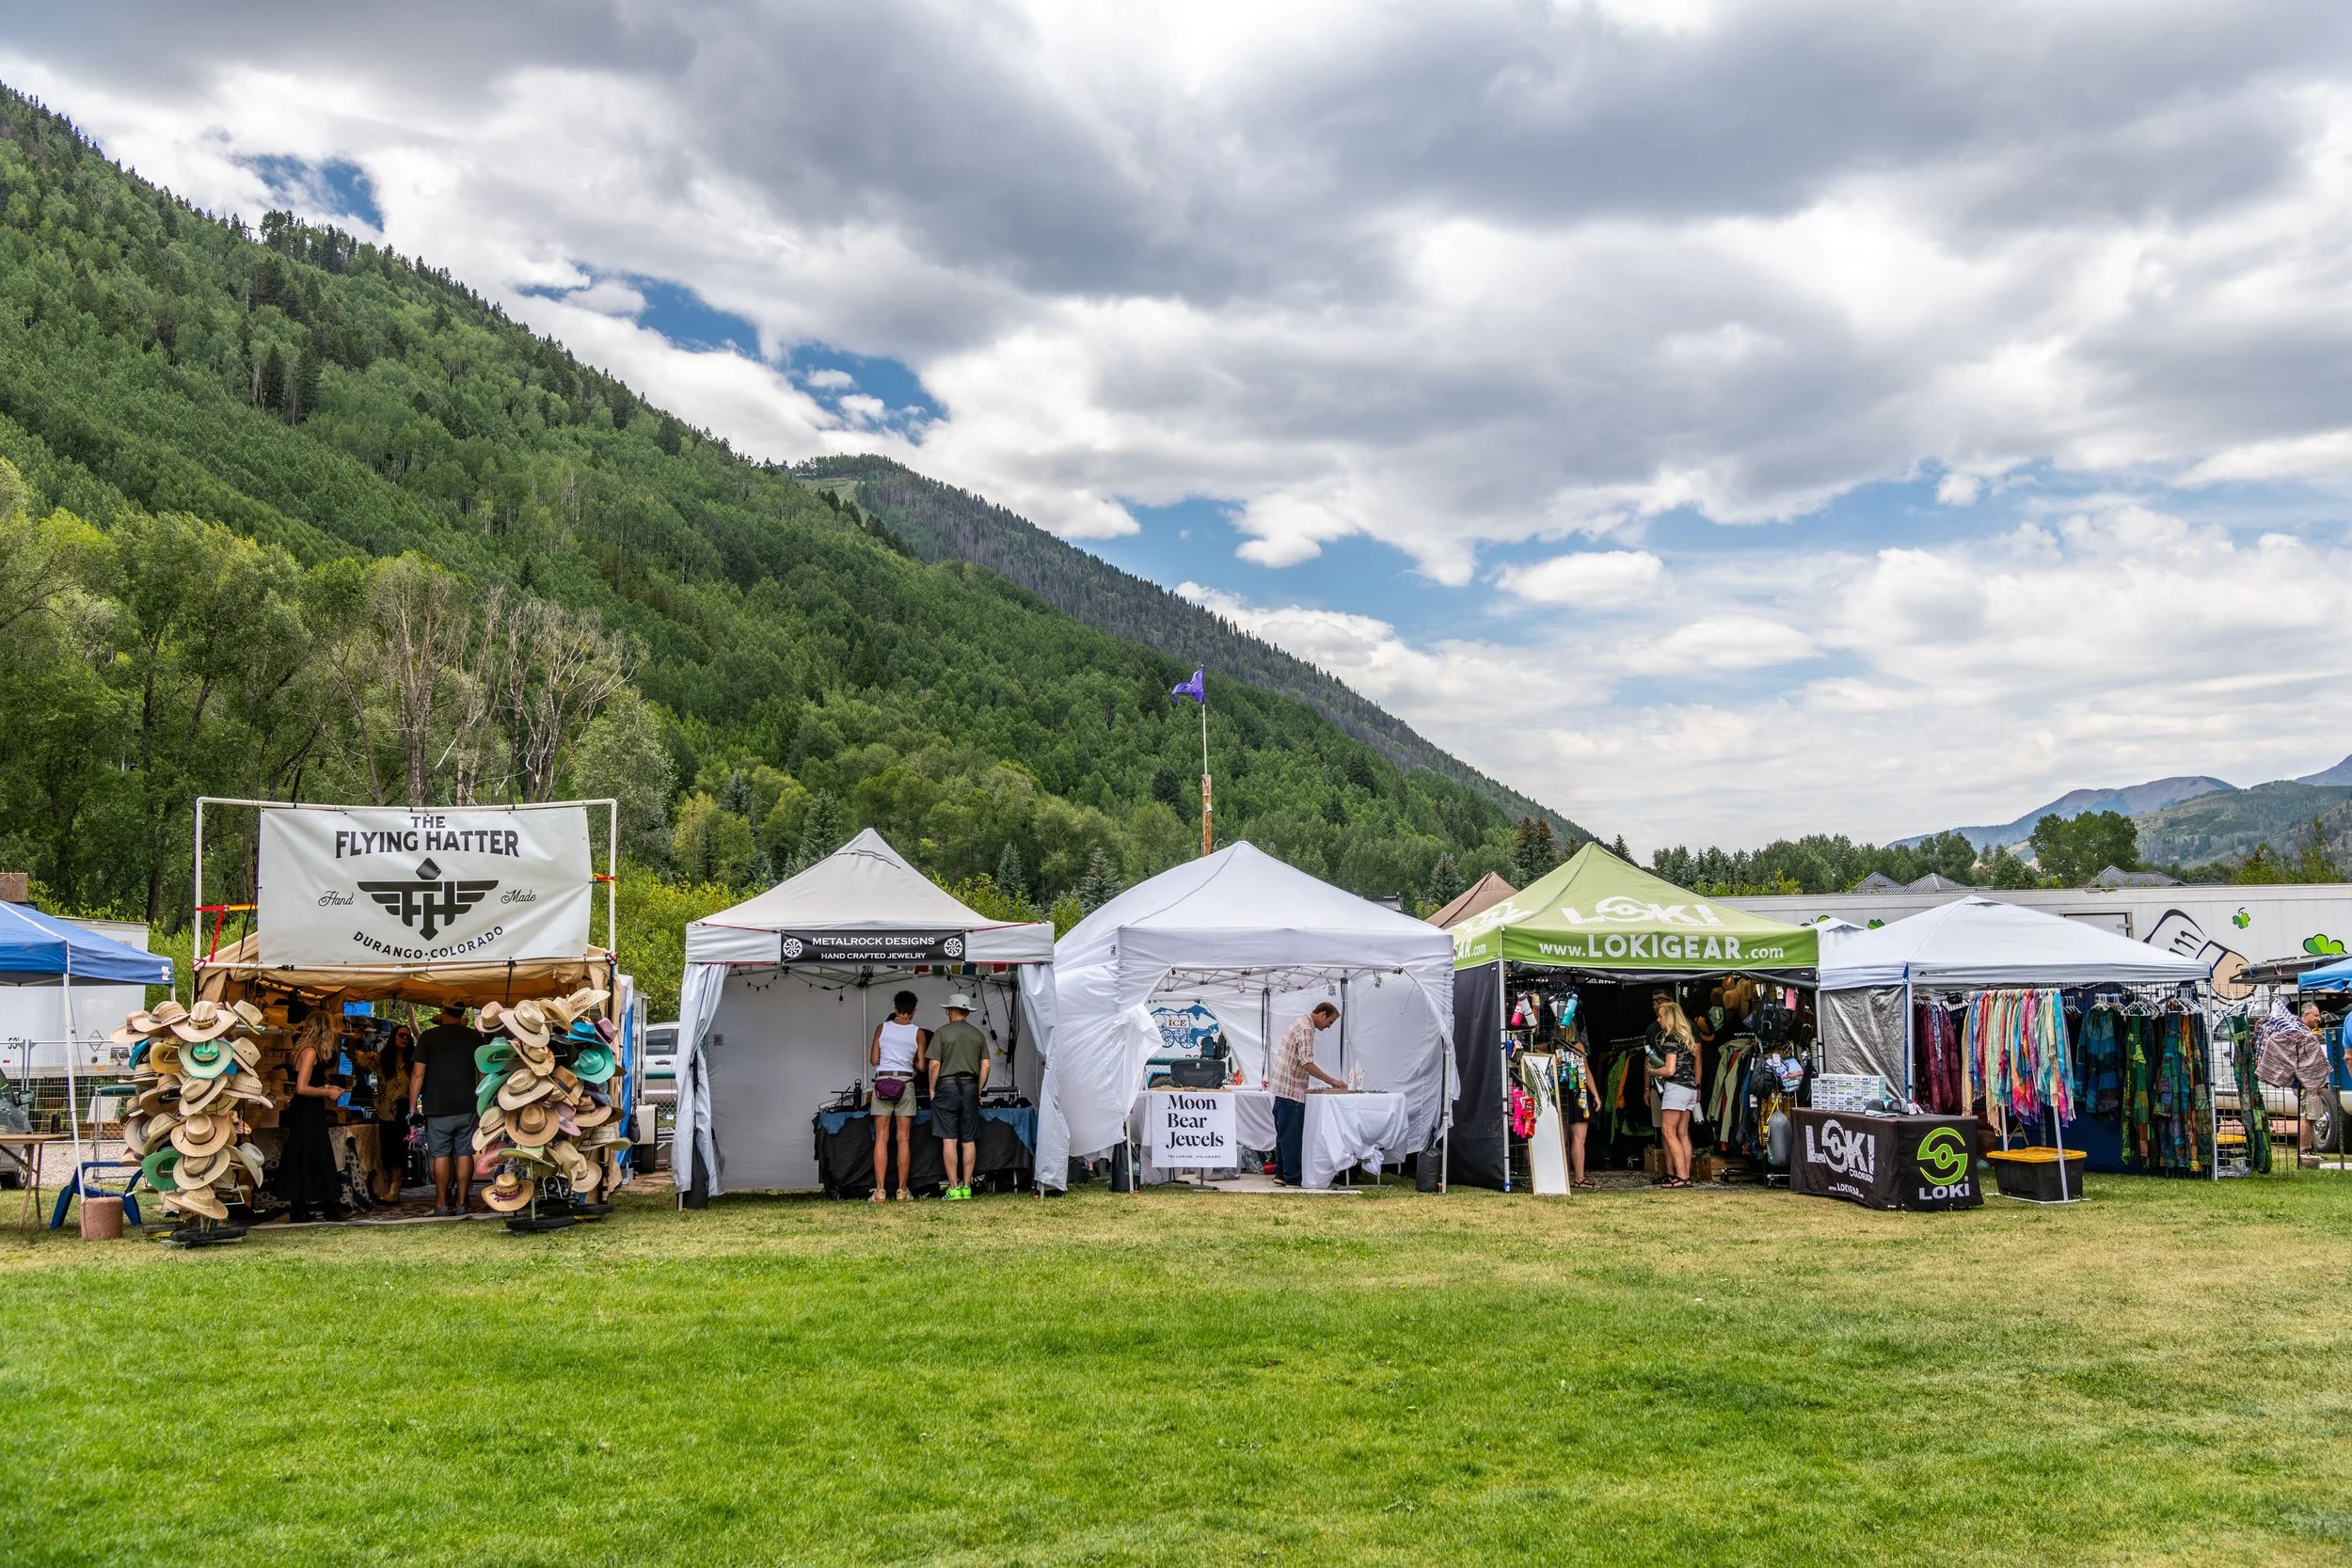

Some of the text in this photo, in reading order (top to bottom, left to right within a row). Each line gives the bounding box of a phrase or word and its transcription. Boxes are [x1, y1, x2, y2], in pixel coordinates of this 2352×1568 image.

[411, 816, 446, 829] THE
[335, 830, 519, 859] FLYING HATTER
[317, 890, 355, 907] Hand
[501, 889, 537, 904] Made
[1561, 895, 1725, 926] LOKI
[352, 926, 504, 959] DURANGO COLORADO
[812, 937, 935, 946] METALROCK DESIGNS
[1538, 933, 1785, 960] www.LOKIGEAR.com
[1168, 1019, 1187, 1027] ICE
[1167, 1094, 1217, 1111] Moon
[1167, 1112, 1208, 1129] Bear
[1165, 1131, 1224, 1149] Jewels
[1804, 1118, 1875, 1175] LOKI
[1918, 1182, 1971, 1201] LOKI
